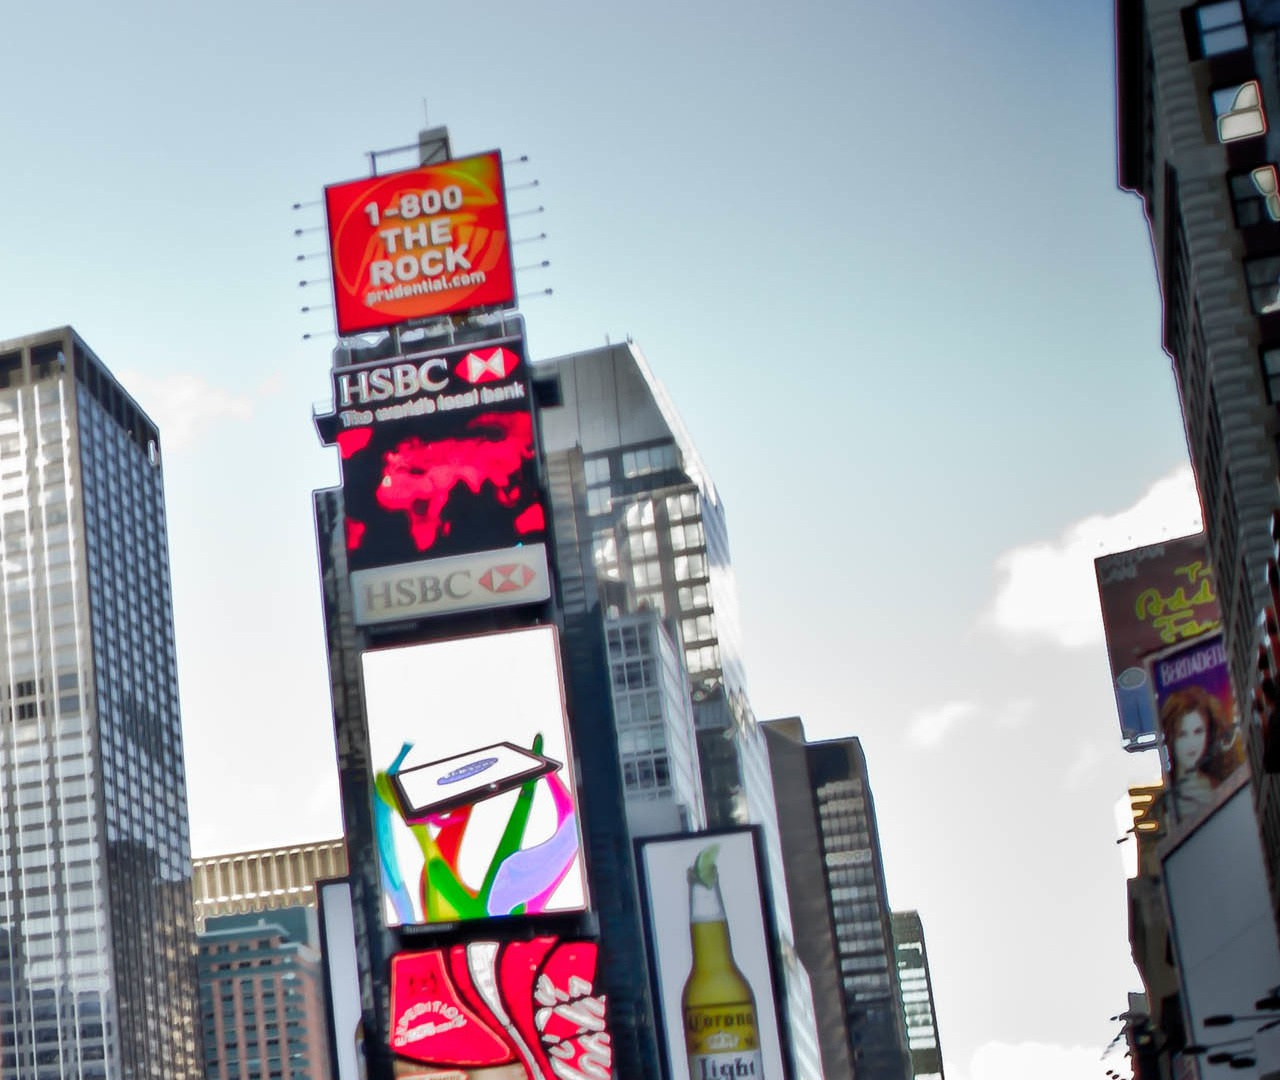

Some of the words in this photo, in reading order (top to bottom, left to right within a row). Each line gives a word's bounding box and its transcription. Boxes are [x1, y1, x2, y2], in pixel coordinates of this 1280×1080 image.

[364, 185, 464, 226] 1-800
[379, 217, 452, 254] THE
[370, 243, 471, 287] ROCK
[365, 270, 485, 306] prudential.com
[338, 358, 449, 407] HSBC
[365, 569, 472, 611] HSBC
